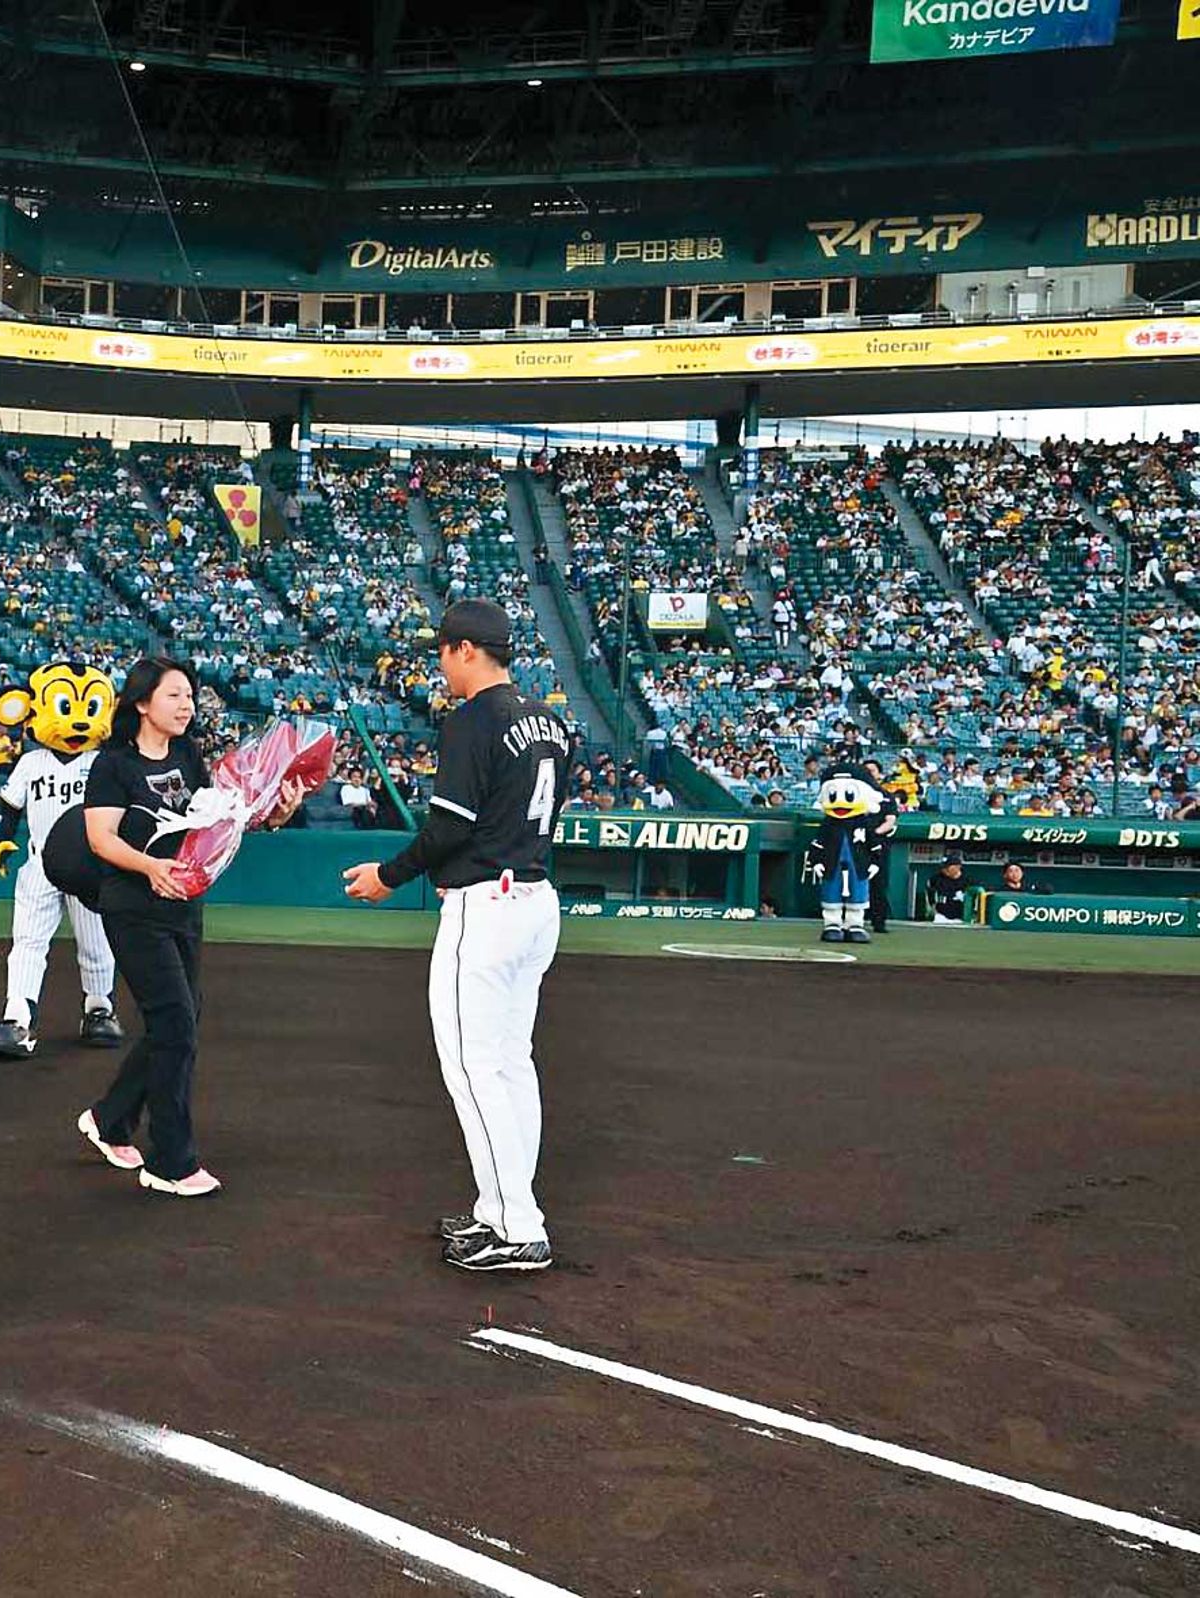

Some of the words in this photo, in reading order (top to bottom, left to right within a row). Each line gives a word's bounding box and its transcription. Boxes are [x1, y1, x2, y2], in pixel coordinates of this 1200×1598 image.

[949, 27, 1035, 50] カナデビア
[807, 213, 983, 257] マイティア
[1086, 212, 1200, 247] HARDL
[346, 240, 491, 275] DigitalArts
[612, 237, 723, 264] 戸田建設
[10, 326, 68, 342] TAIWAN
[1023, 327, 1098, 339] TAIWAN
[655, 342, 721, 353] TAIWAN
[31, 774, 87, 805] Tige
[527, 757, 556, 835] 4
[634, 821, 749, 851] ALINCO
[946, 824, 988, 841] DTS
[1031, 828, 1087, 844] エイジェック
[1136, 829, 1180, 848] DTS
[1024, 907, 1090, 923] SOMPO
[1103, 910, 1184, 926] 損保ジャパン
